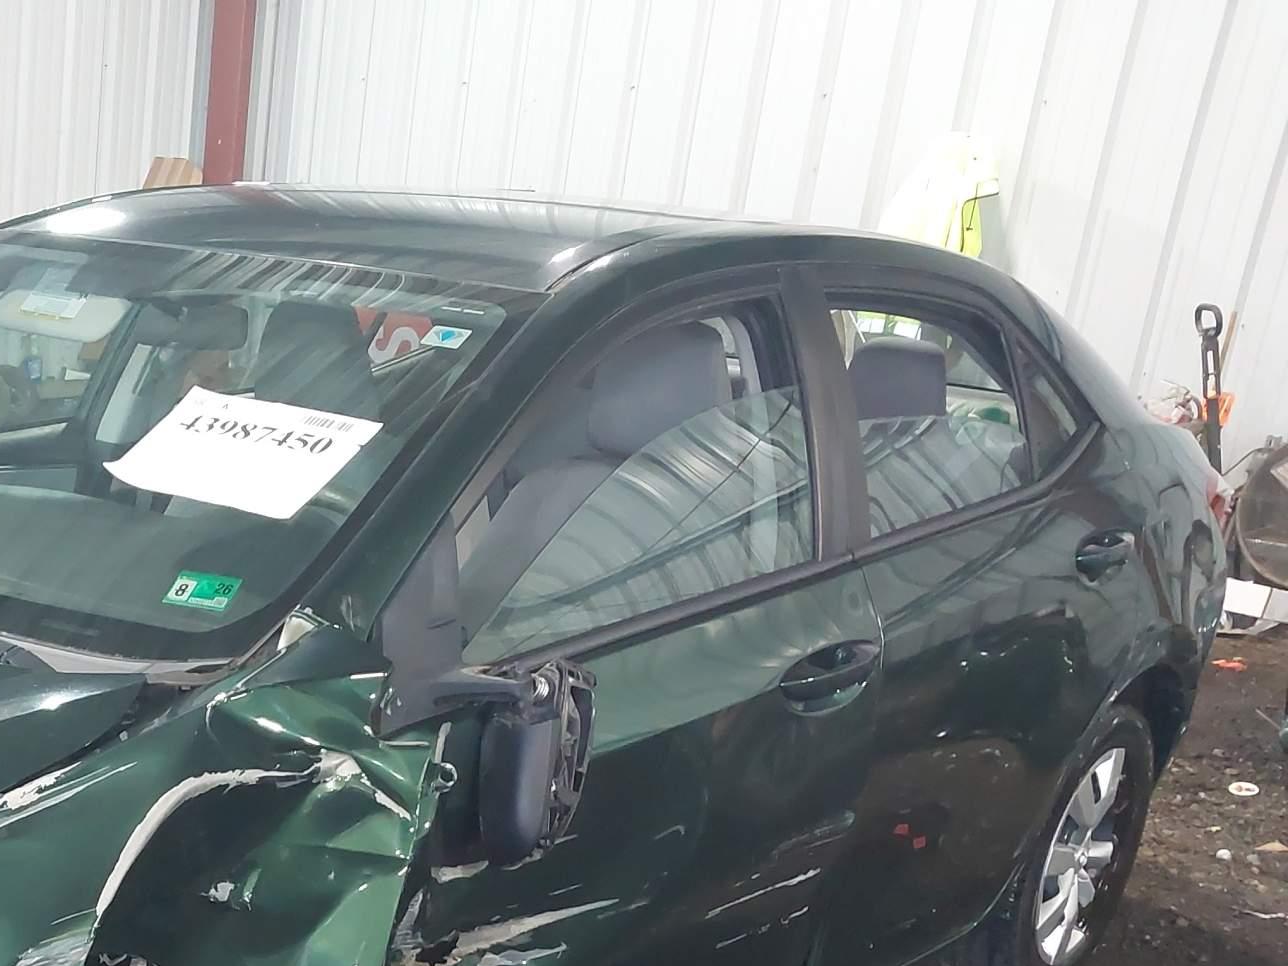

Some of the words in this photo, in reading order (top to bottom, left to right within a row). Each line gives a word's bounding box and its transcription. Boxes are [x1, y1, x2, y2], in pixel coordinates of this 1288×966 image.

[179, 414, 334, 455] 43987450
[174, 583, 189, 597] 8
[214, 582, 234, 596] 26
